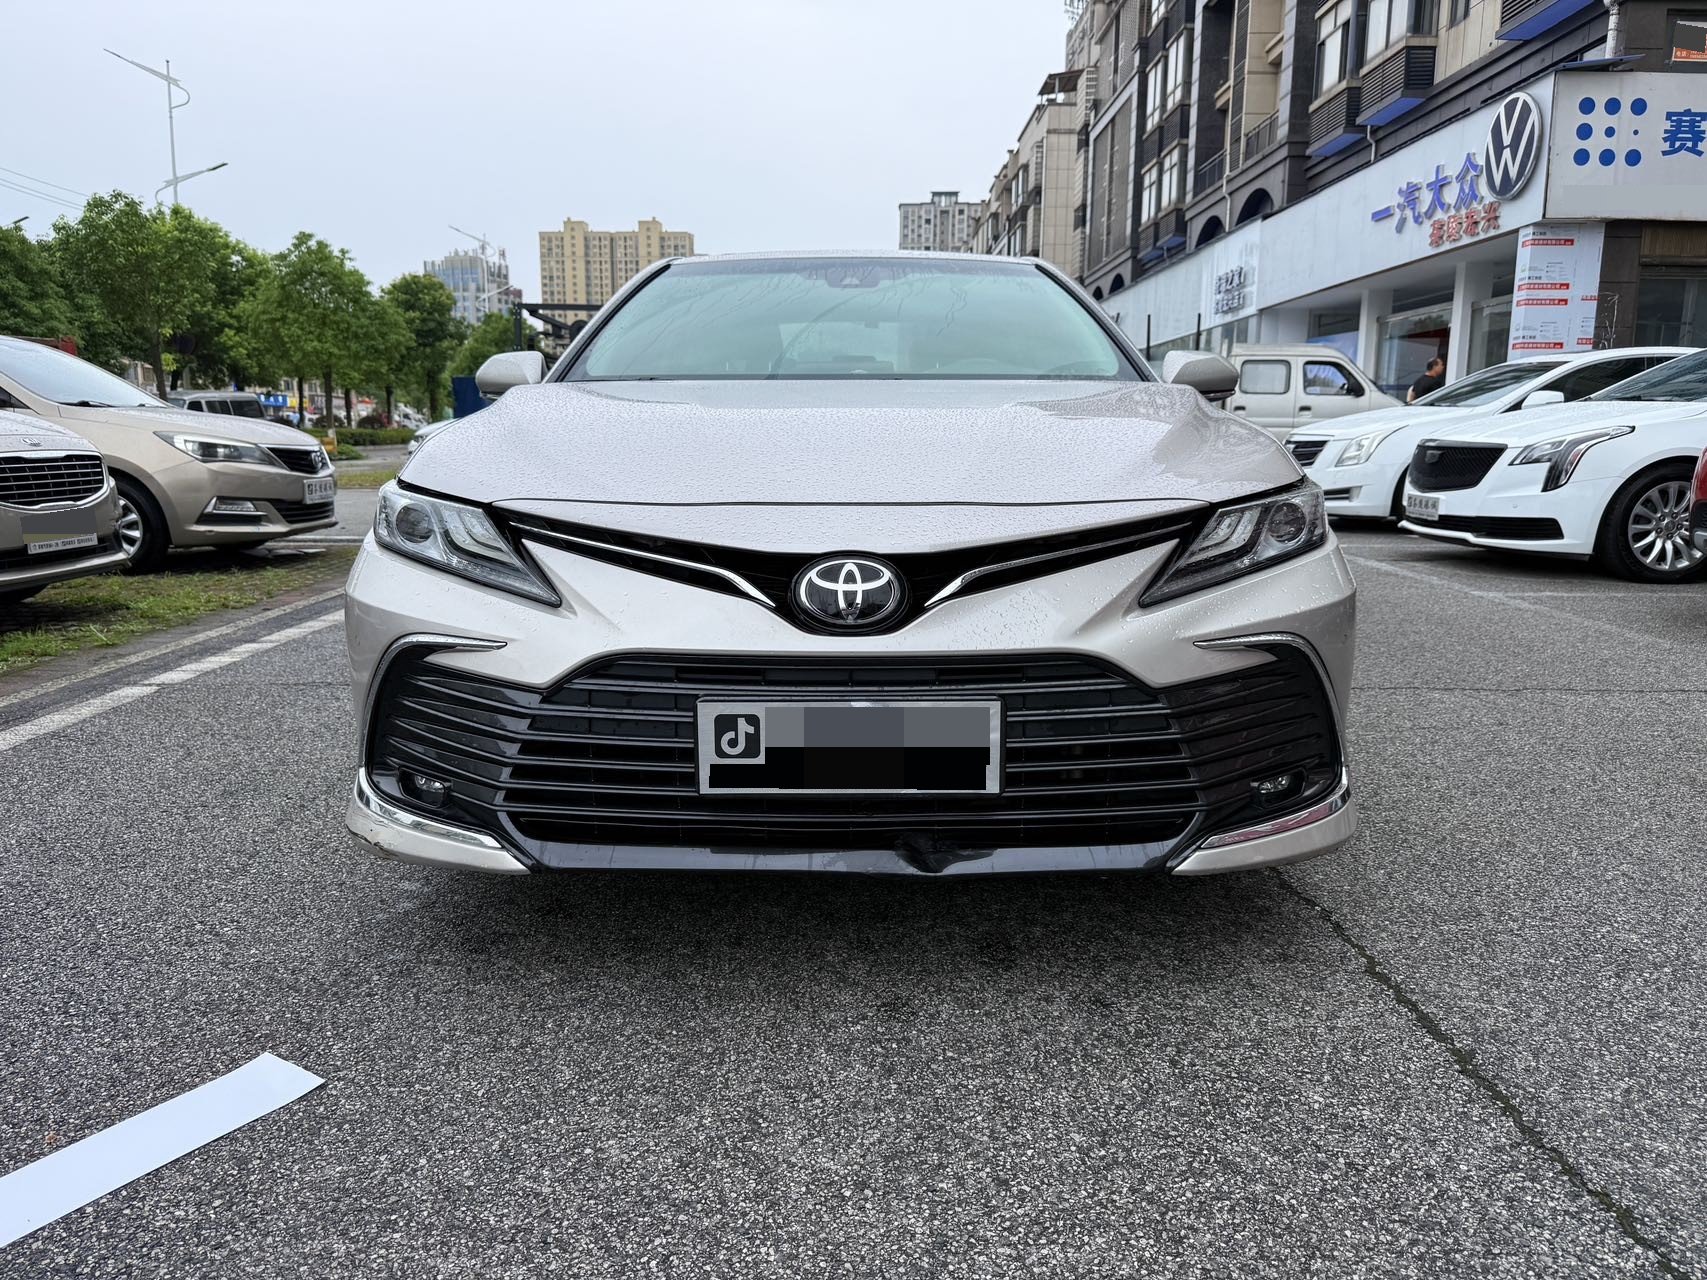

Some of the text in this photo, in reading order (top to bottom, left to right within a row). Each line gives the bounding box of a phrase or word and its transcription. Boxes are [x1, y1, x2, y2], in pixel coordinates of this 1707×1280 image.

[1661, 108, 1707, 157] 赛
[1371, 152, 1484, 234] 一汽大众
